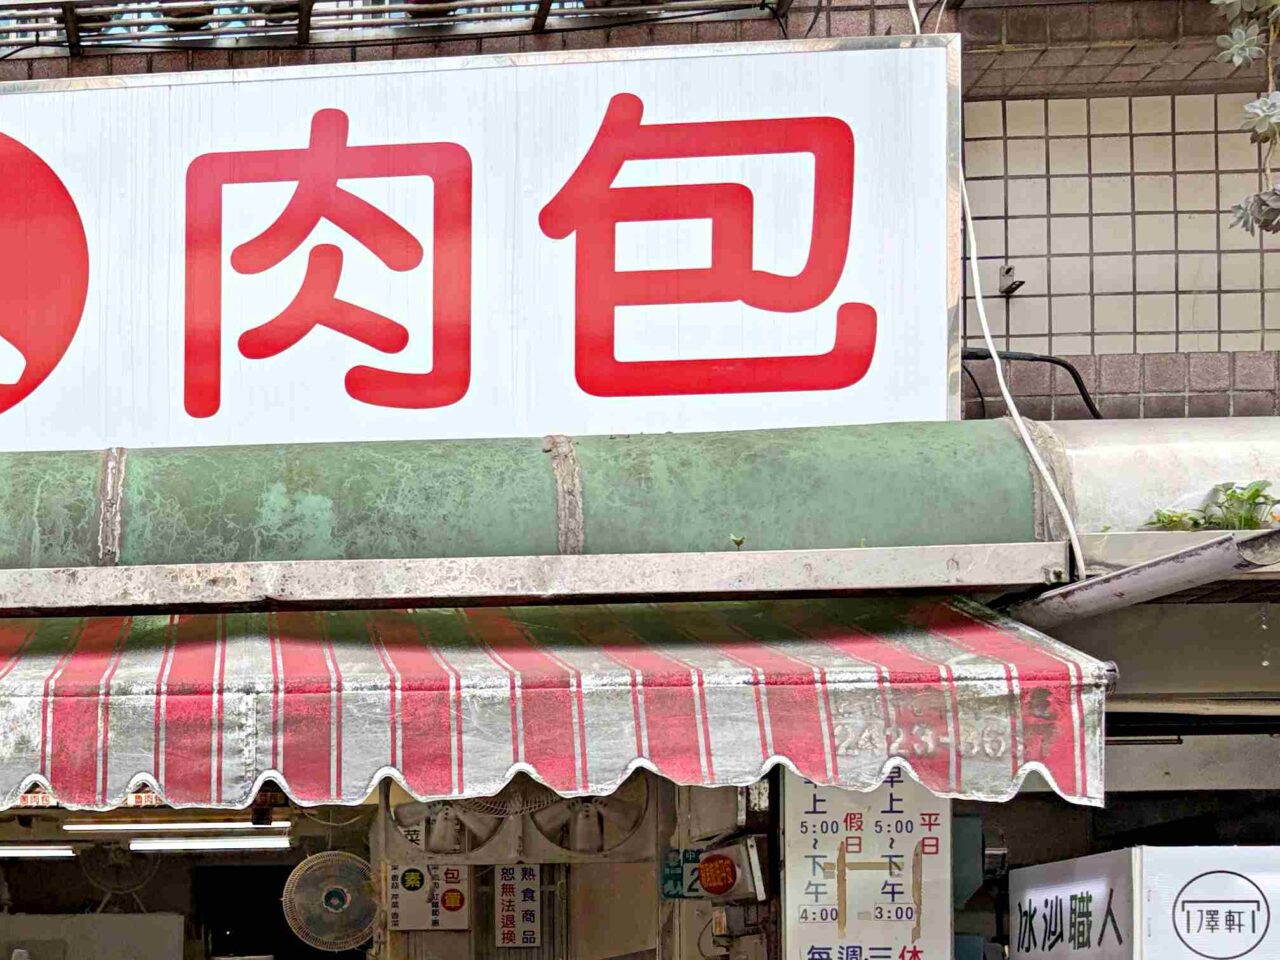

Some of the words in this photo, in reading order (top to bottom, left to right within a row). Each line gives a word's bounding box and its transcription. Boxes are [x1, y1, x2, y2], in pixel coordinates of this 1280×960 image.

[800, 820, 839, 834] 5:00
[843, 812, 864, 853] 假日
[874, 820, 914, 834] 5:00
[919, 812, 941, 855] 平日
[404, 871, 421, 888] 素
[443, 867, 461, 885] 包
[804, 855, 828, 902] 下午
[881, 855, 905, 902] 下午
[500, 867, 516, 945] 恕無法退換
[520, 867, 536, 944] 熟食商品
[800, 908, 839, 921] 4:00
[874, 906, 914, 920] 3:00
[1017, 887, 1124, 953] 冰沙職人
[1197, 909, 1246, 934] 澤軒
